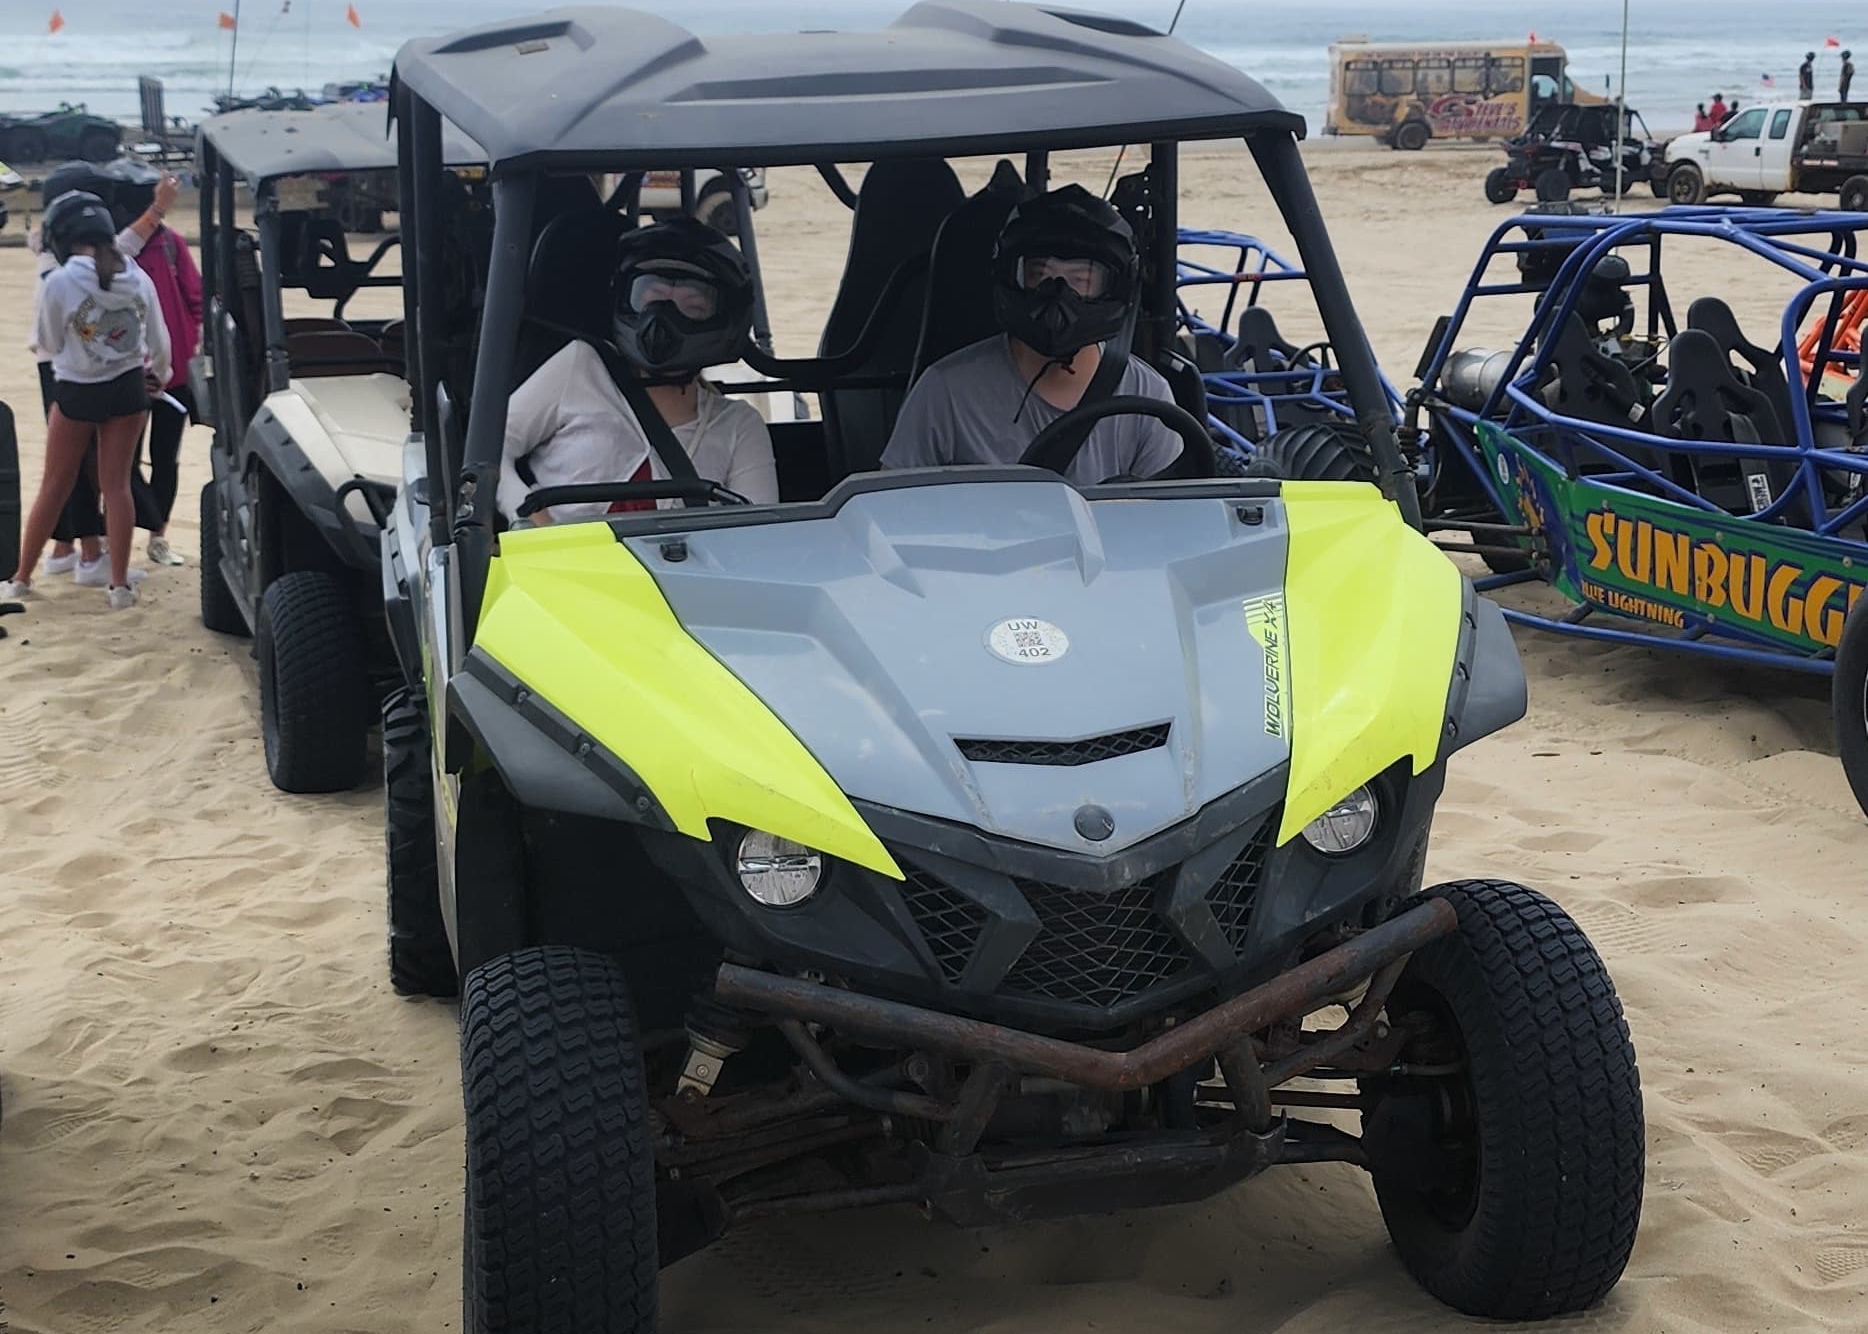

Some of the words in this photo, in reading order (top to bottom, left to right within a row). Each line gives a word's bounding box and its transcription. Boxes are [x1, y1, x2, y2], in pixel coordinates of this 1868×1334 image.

[1607, 590, 1684, 629] LIGHTNING
[1007, 620, 1038, 631] UW
[1018, 647, 1052, 658] 402
[1264, 628, 1281, 737] WOLVERINE
